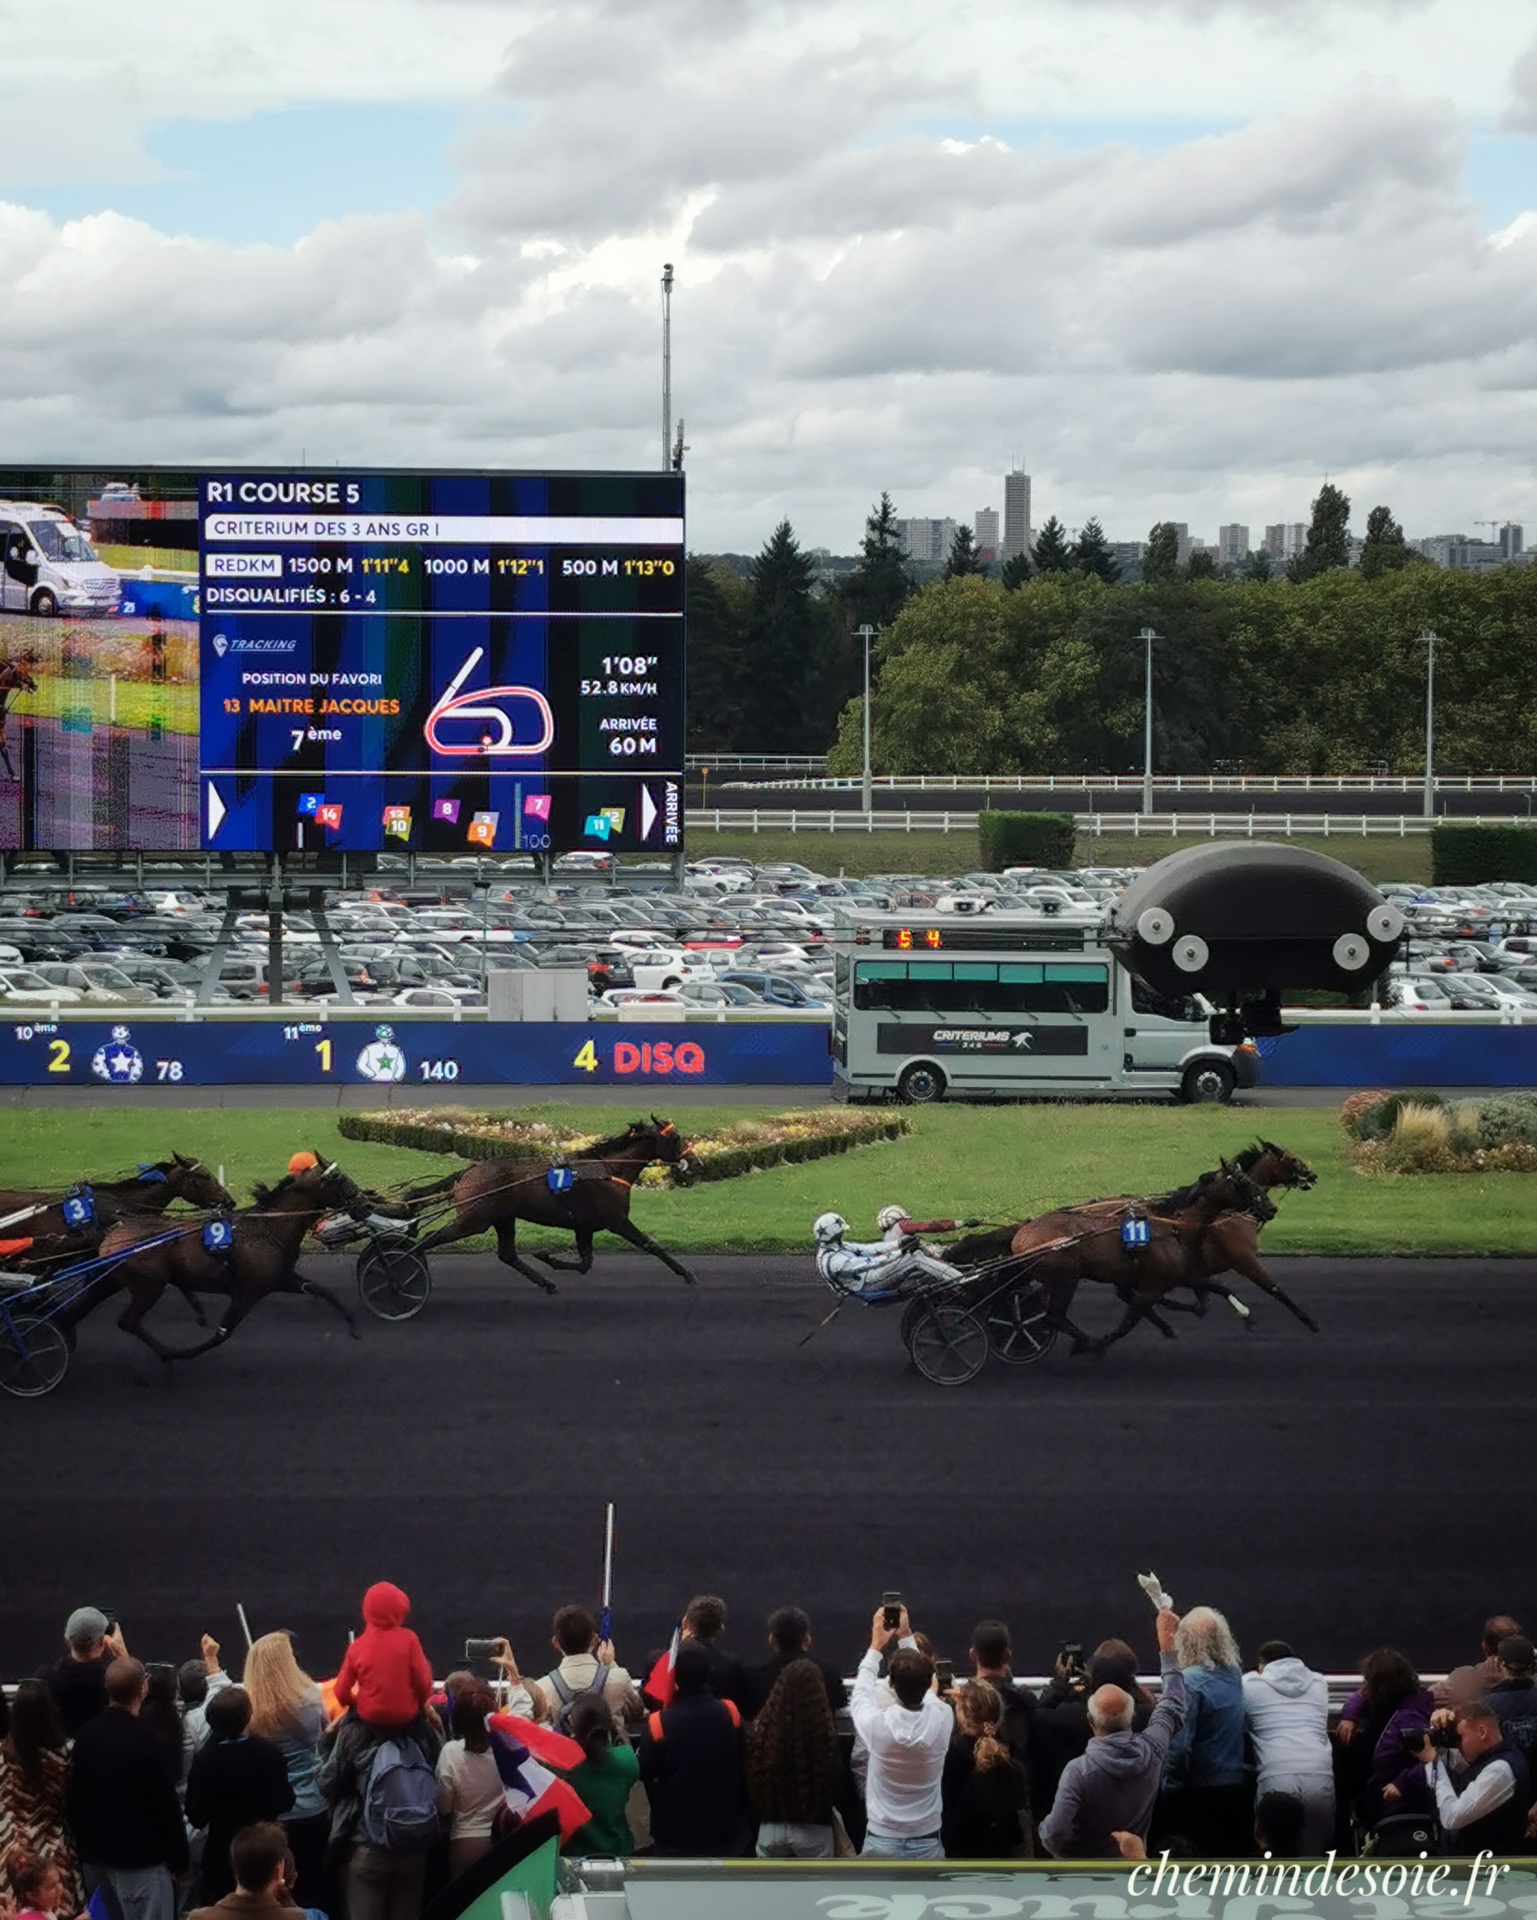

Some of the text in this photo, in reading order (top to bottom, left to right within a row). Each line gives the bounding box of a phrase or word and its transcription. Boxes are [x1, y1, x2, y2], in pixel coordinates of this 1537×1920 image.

[207, 482, 360, 504] R1 COURSE 5
[214, 520, 308, 535] CRITERIUM
[314, 521, 347, 536] DES
[352, 522, 361, 536] 3
[366, 522, 401, 536] ANS
[406, 522, 430, 536] GR
[214, 558, 276, 572] REDKM
[288, 558, 331, 573] 1500
[336, 558, 353, 573] M
[424, 559, 468, 574] 1000
[473, 559, 490, 574] M
[562, 560, 597, 575] 500
[602, 560, 618, 575] M
[206, 585, 326, 604] DISQUALIFIÉS
[339, 589, 350, 604] 6
[366, 589, 377, 604] 4
[230, 639, 297, 650] TRACKING
[242, 673, 382, 685] POSITION DU FAVORI
[581, 680, 657, 695] 52.8 KM/H
[223, 698, 400, 715] 13 MAITRE JACQUES
[600, 716, 657, 730] ARRIVÉE
[610, 737, 656, 754] 60 M
[306, 796, 317, 809] 2
[442, 802, 453, 815] 8
[534, 799, 544, 811] 7
[321, 808, 338, 821] 14
[665, 781, 681, 843] ARRIVÉE
[391, 820, 407, 832] 10
[477, 825, 487, 837] 9
[593, 819, 605, 831] 11
[522, 834, 552, 849] 100
[932, 1030, 1011, 1041] CRITERIUMS
[48, 1039, 71, 1072] 2
[315, 1039, 331, 1071] 1
[573, 1039, 705, 1074] 4 DISQ
[156, 1061, 183, 1081] 78
[420, 1060, 459, 1080] 140
[553, 1168, 565, 1188] 7
[69, 1199, 85, 1220] 3
[210, 1222, 225, 1244] 9
[1125, 1220, 1146, 1241] 11
